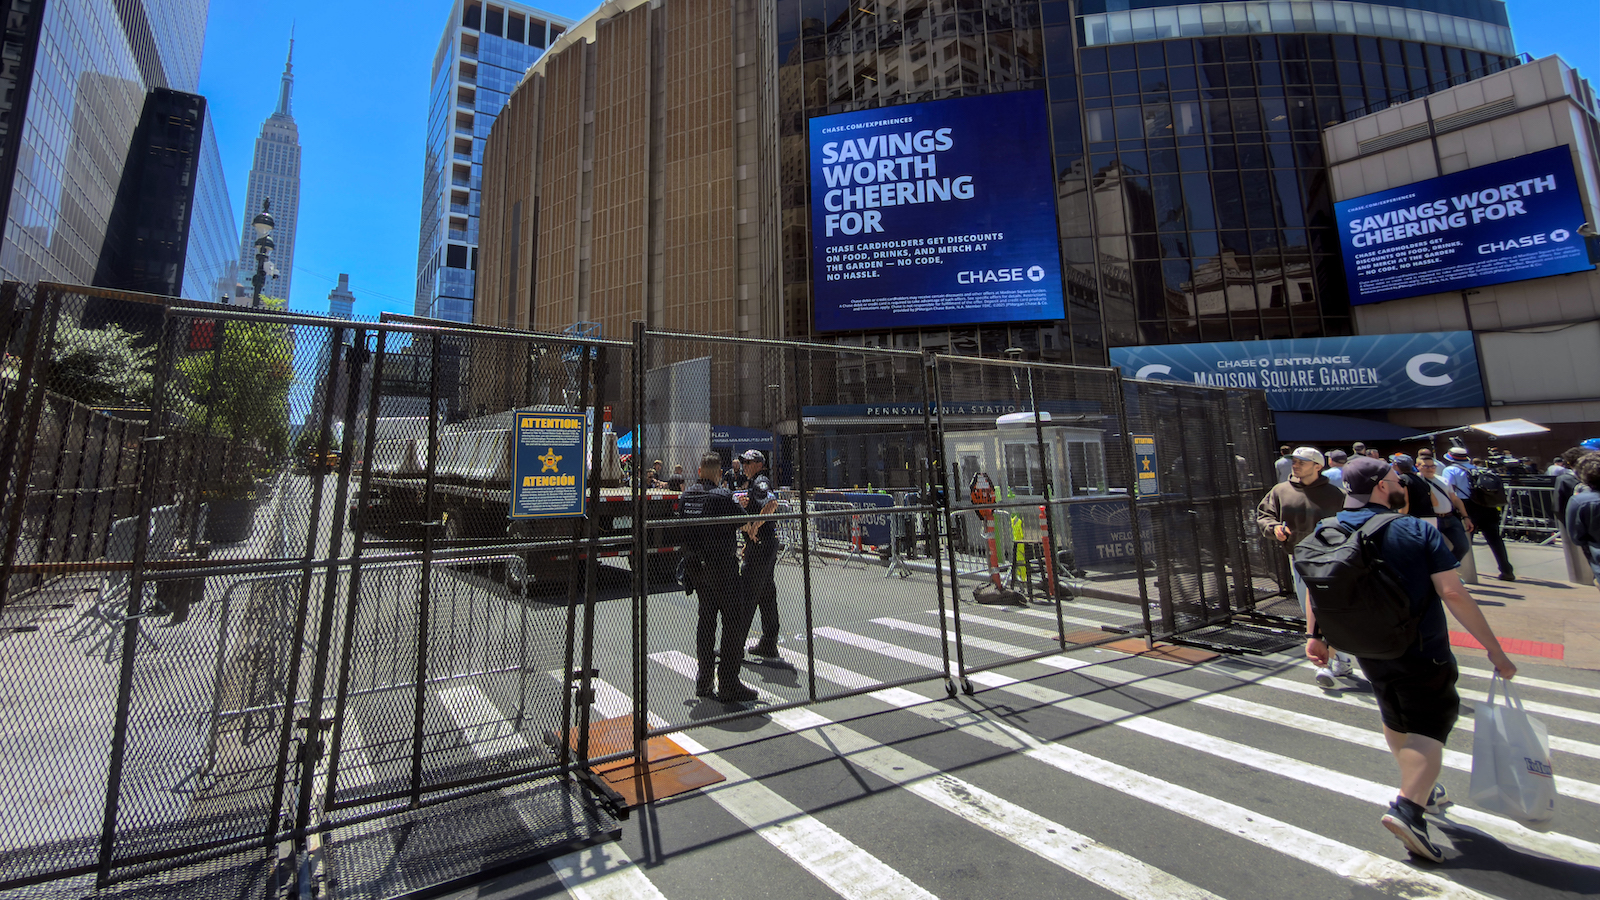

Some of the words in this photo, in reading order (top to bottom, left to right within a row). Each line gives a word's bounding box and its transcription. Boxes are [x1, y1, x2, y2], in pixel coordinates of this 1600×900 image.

[822, 116, 913, 134] CHASE.COM/EXPERIENCES
[822, 127, 954, 164] SAVINGS
[822, 154, 937, 188] WORTH
[824, 176, 975, 212] CHEERING
[1348, 193, 1416, 213] CHASE.COM/EXPERIENCES
[1349, 199, 1448, 234] SAVINGS
[1451, 174, 1556, 211] WORTH
[825, 211, 884, 237] FOR
[1352, 213, 1467, 248] CHEERING
[1472, 200, 1527, 225] FOR
[826, 244, 854, 254] CHASE
[857, 239, 924, 252] CARDHOLDERS
[927, 236, 945, 246] GET
[947, 232, 1004, 244] DISCOUNTS
[826, 253, 840, 263] ON
[842, 251, 871, 263] FOOD,
[873, 247, 912, 260] DRINKS,
[914, 247, 935, 256] AND
[938, 244, 972, 255] MERCH
[975, 243, 987, 251] AT
[1355, 251, 1376, 260] CHASE
[1377, 241, 1428, 255] CARDHOLDERS
[1429, 237, 1444, 246] GET
[1356, 253, 1394, 265] DISCOUNTS
[1408, 247, 1430, 256] FOOD,
[1432, 241, 1464, 251] DRINKS,
[1478, 233, 1547, 255] CHASE
[826, 263, 844, 272] THE
[846, 260, 883, 271] GARDEN
[897, 257, 912, 267] NO
[915, 255, 943, 267] CODE,
[1373, 259, 1396, 268] MERCH
[1424, 248, 1455, 259] GARDEN
[1378, 265, 1398, 273] CODE,
[1412, 257, 1442, 267] HASSLE.
[827, 272, 841, 281] NO
[843, 270, 880, 281] HASSLE.
[957, 268, 1024, 285] CHASE
[1217, 359, 1257, 369] CHASE
[1274, 355, 1351, 367] ENTRANCE
[1405, 352, 1453, 387] C
[1193, 371, 1257, 388] MADISON
[1260, 368, 1316, 388] SQUARE
[1319, 367, 1379, 386] GARDEN
[867, 406, 965, 415] PENNSYLANIA
[521, 418, 581, 429] ATTENTION:
[523, 473, 575, 487] ATENCIÓN
[1110, 530, 1150, 541] WELCME
[1095, 543, 1123, 558] THE
